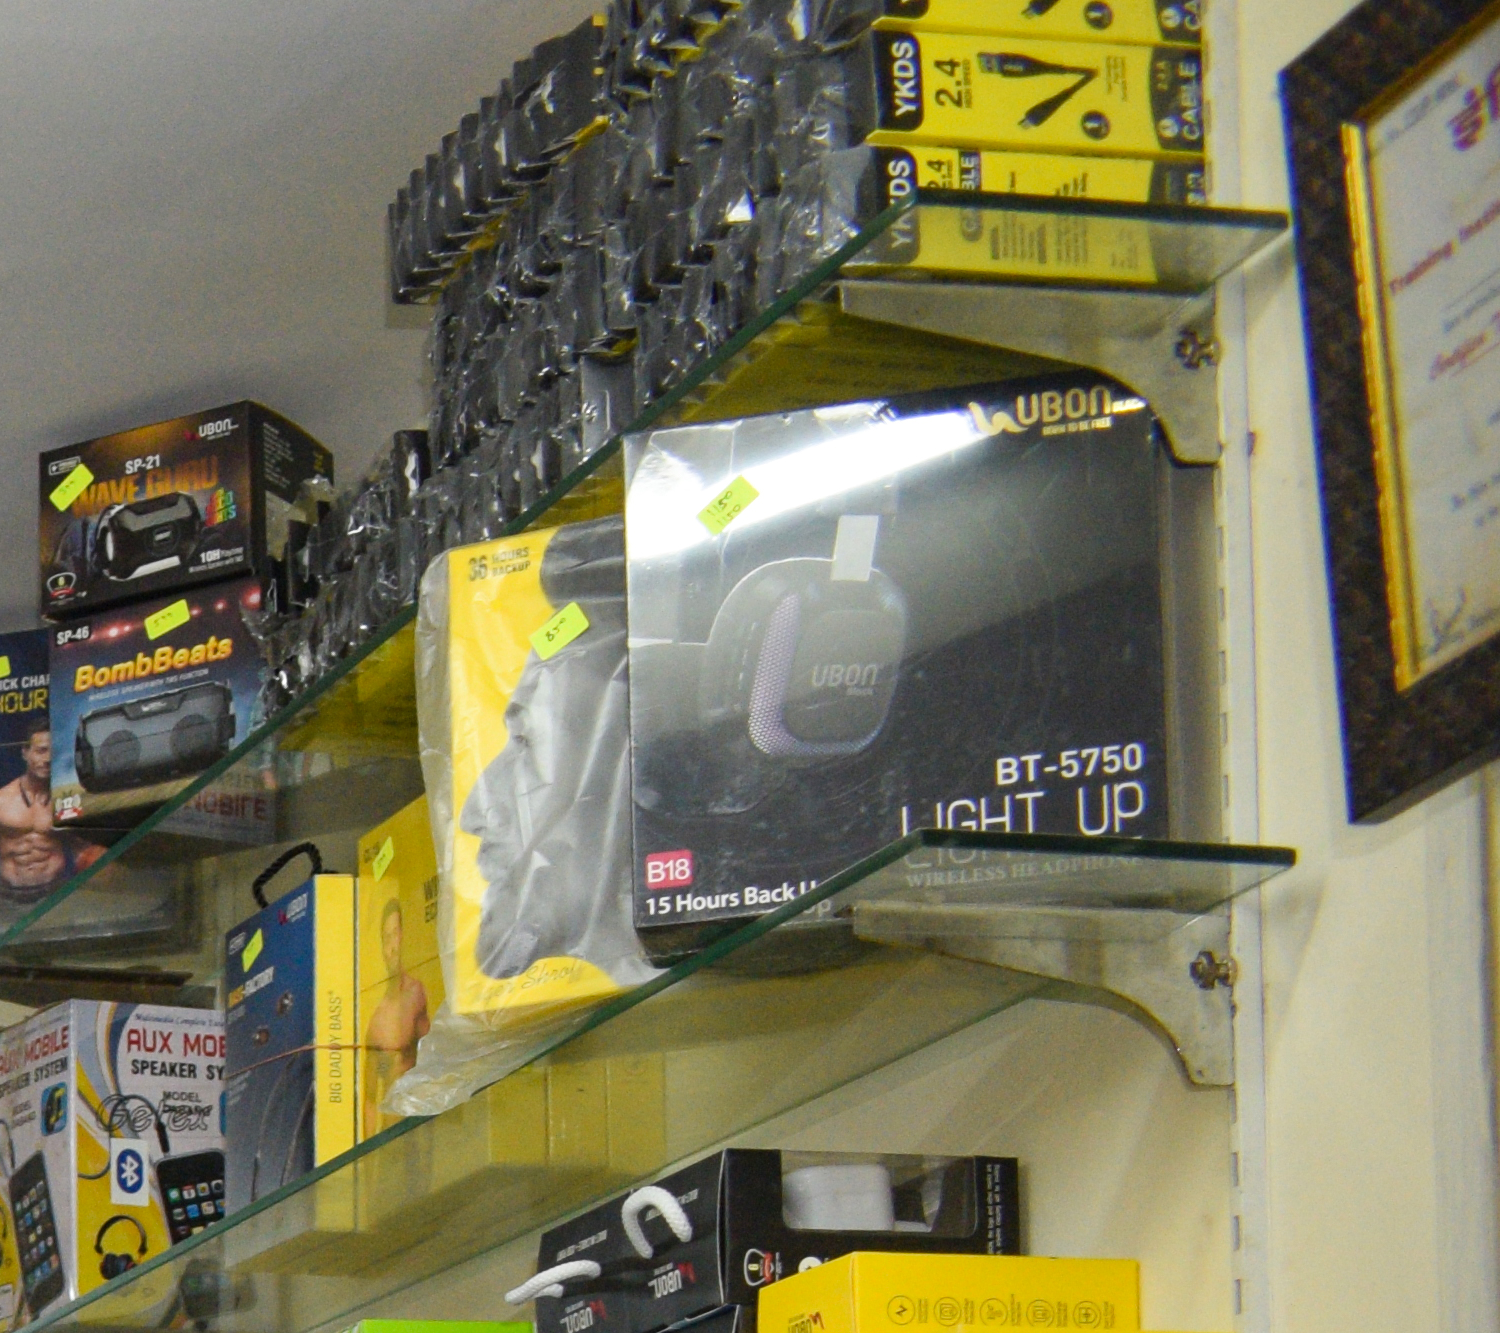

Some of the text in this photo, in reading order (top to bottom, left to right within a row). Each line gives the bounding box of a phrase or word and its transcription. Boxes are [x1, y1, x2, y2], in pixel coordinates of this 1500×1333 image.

[891, 40, 917, 117] YKDS
[933, 57, 963, 109] 2.4
[1016, 385, 1112, 427] UBON
[199, 417, 233, 438] UBON
[125, 454, 161, 475] SP-21
[468, 547, 530, 582] 36 HOURS
[56, 626, 90, 646] SP-46
[74, 635, 233, 693] BombBeats
[810, 663, 879, 689] UBON
[995, 743, 1144, 786] BT-5750
[646, 859, 690, 884] B18
[646, 884, 795, 915] 15 Hours Back
[23, 1025, 69, 1062] MOBILE
[127, 1027, 226, 1058] AUX MOB
[328, 994, 341, 1104] BIG DADDY BASS
[33, 1056, 68, 1083] SYSTEM
[131, 1058, 197, 1079] SPEAKER
